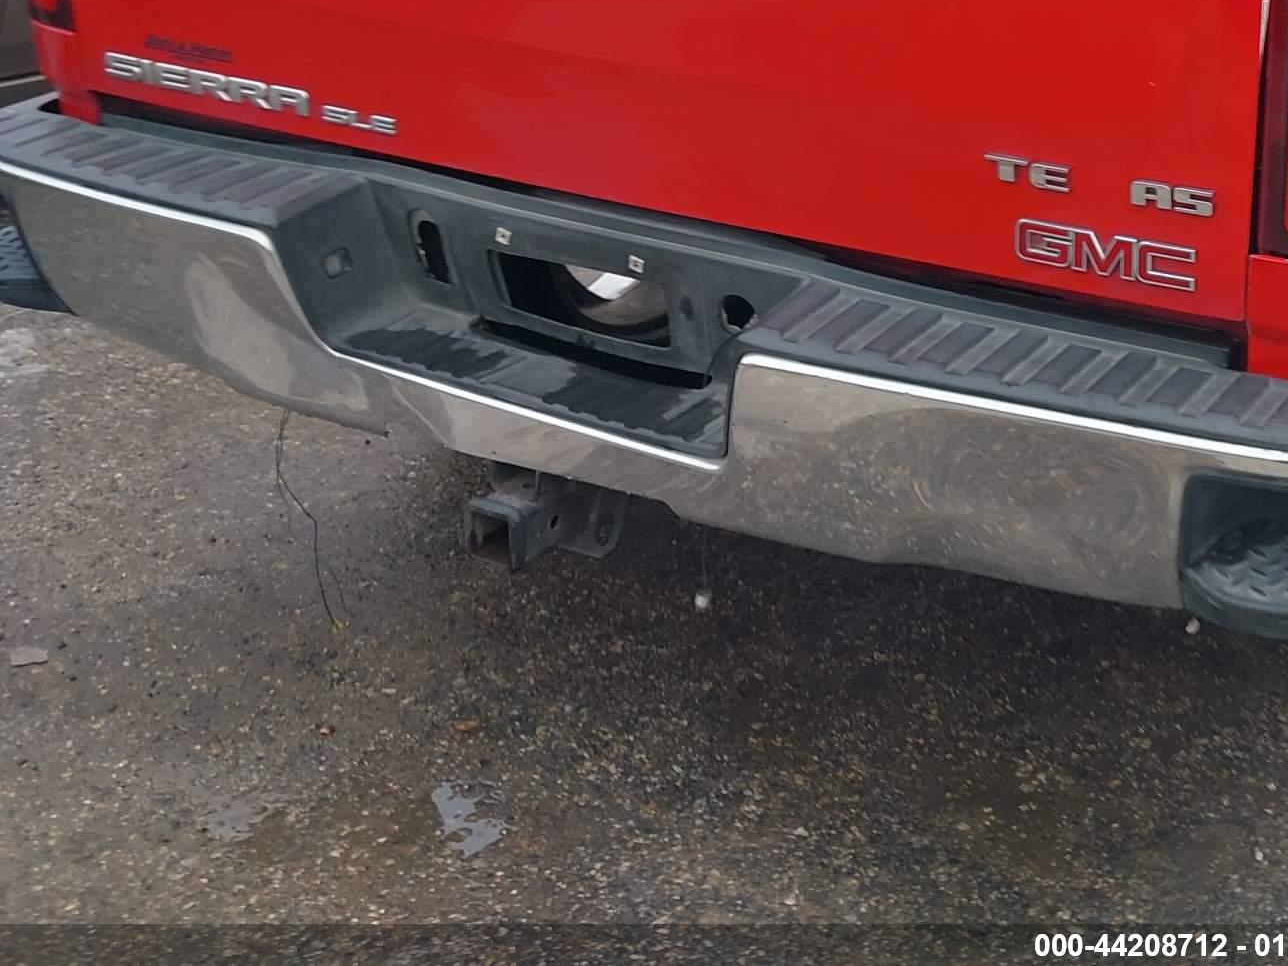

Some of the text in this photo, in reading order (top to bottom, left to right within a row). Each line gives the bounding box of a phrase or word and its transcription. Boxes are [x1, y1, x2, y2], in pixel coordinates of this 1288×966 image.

[104, 51, 398, 135] SIERRA SLE
[1015, 218, 1198, 292] GMC
